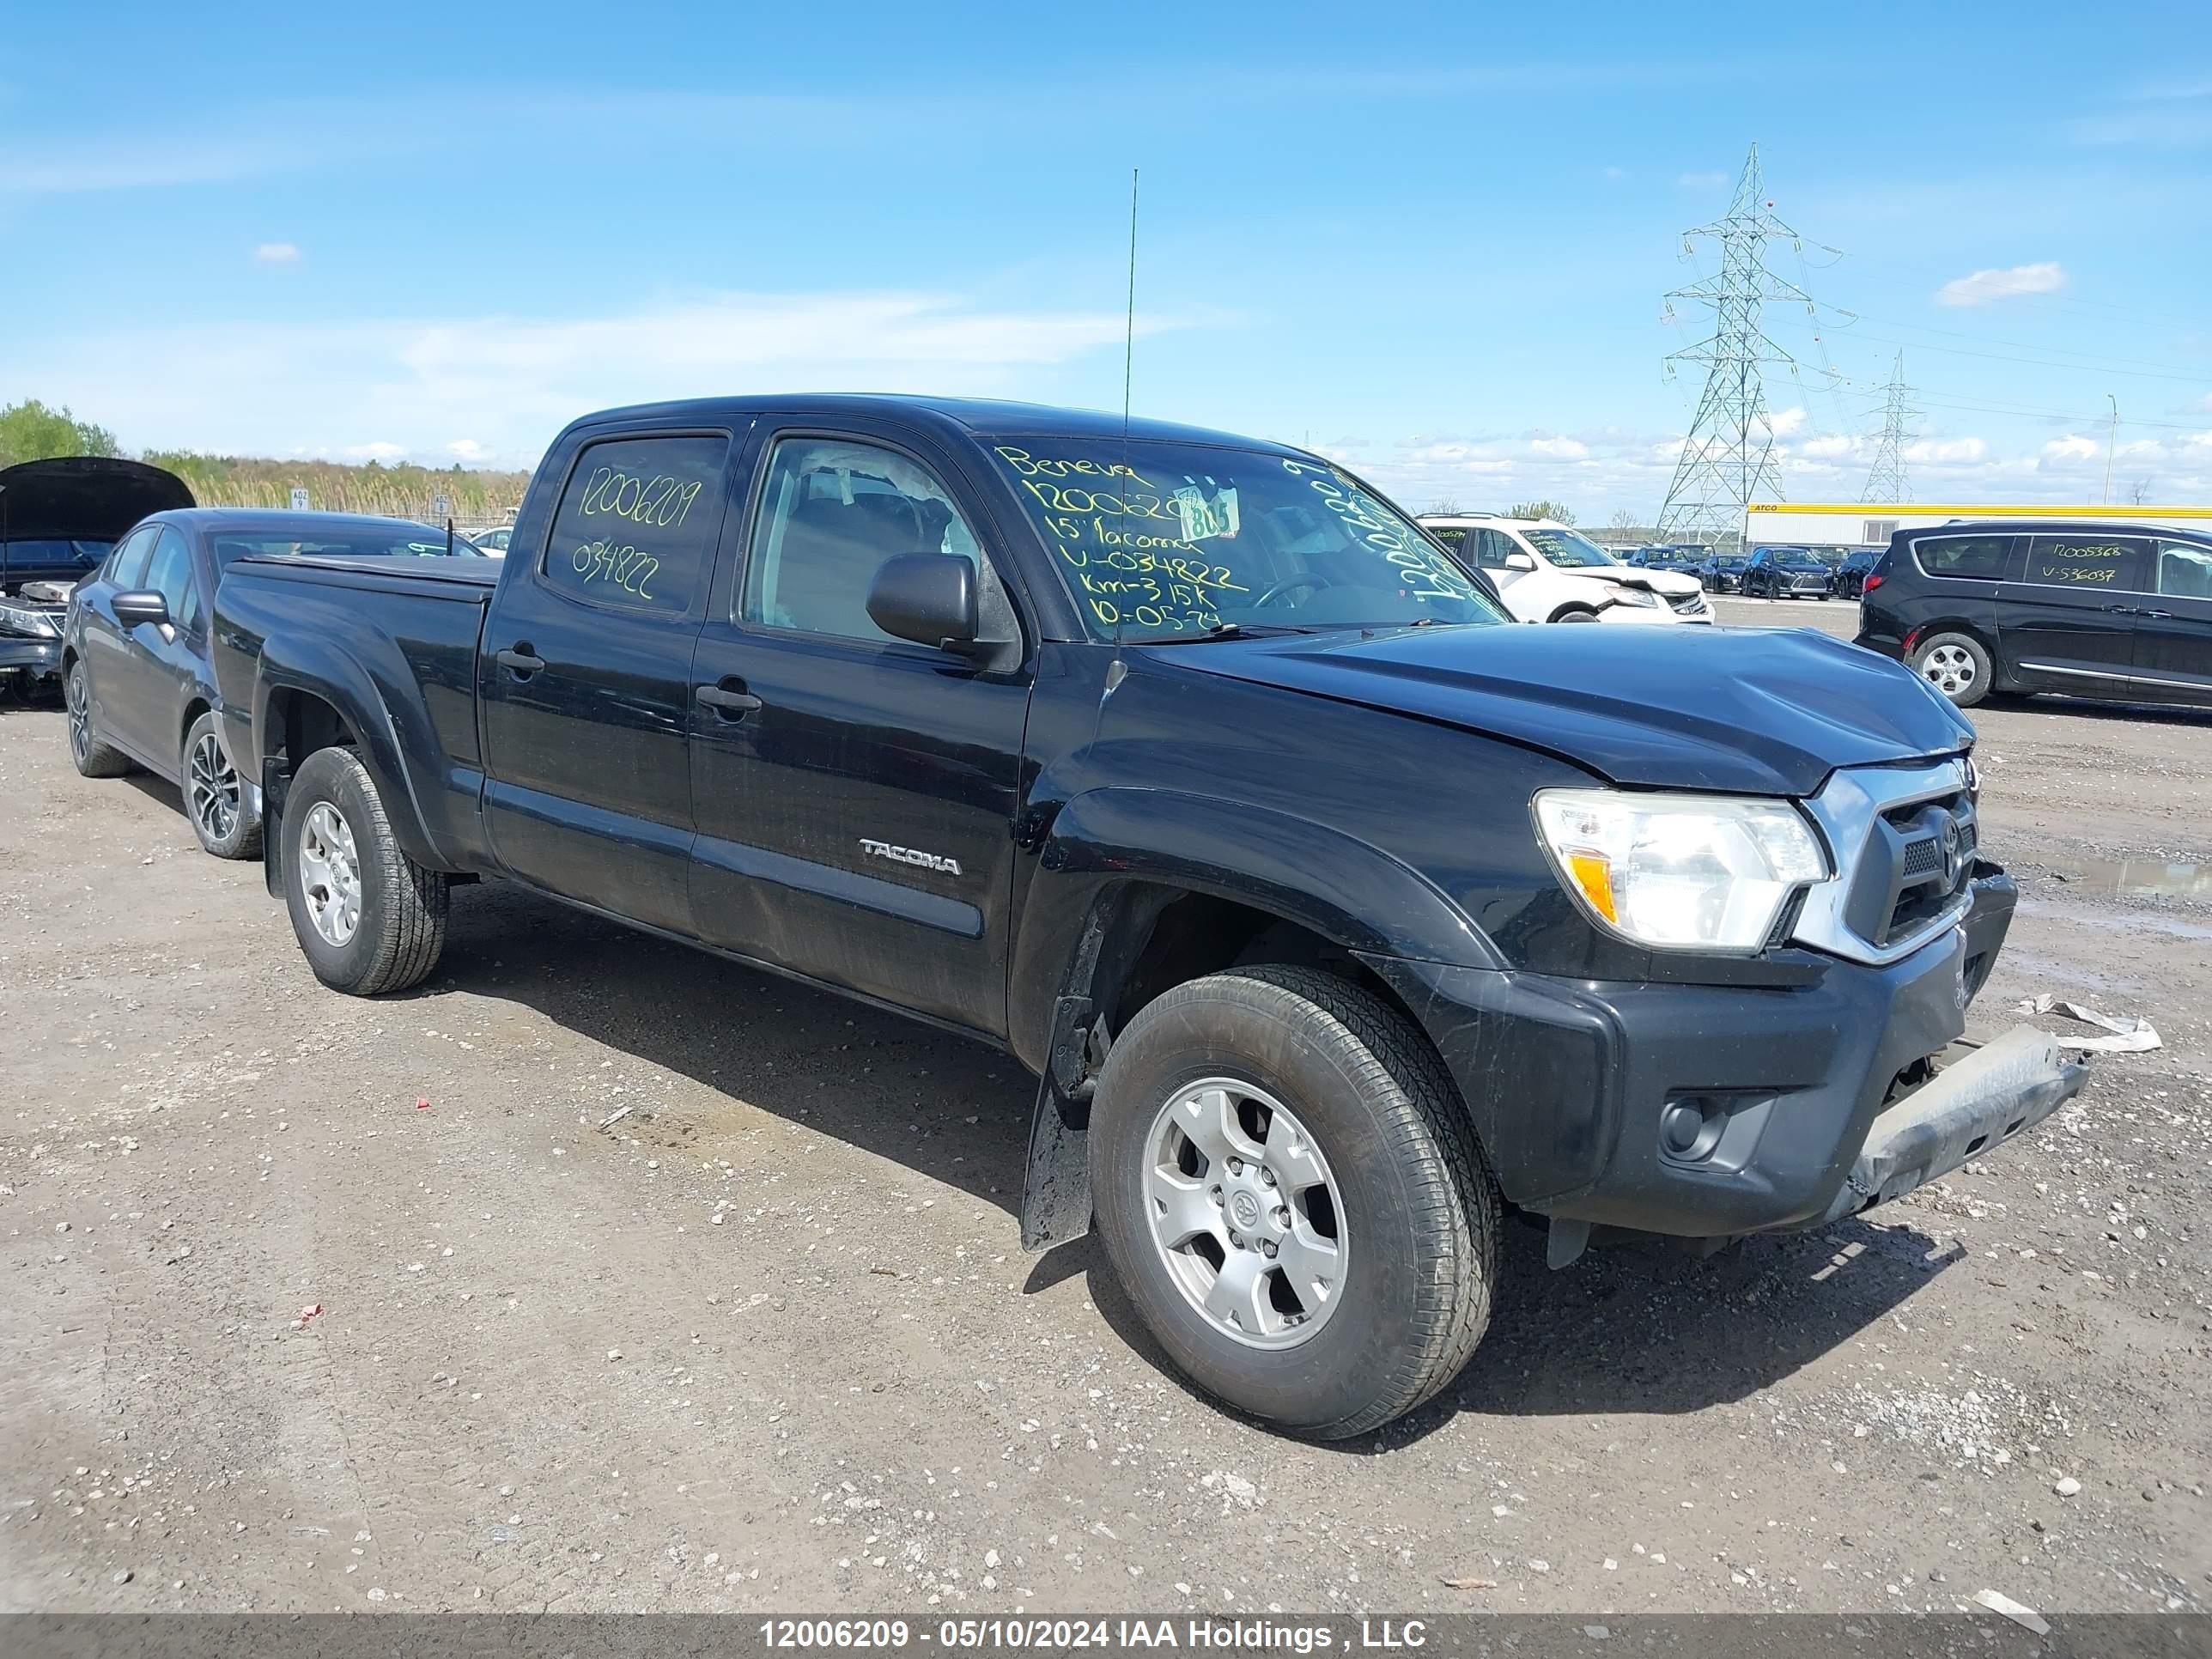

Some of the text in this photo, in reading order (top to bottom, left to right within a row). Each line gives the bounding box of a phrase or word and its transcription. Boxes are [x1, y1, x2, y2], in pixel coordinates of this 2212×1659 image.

[578, 468, 702, 527] 12006209
[1192, 502, 1230, 538] 805
[2054, 544, 2121, 557] 12005368
[573, 541, 659, 599] 034822
[2043, 567, 2115, 582] V-536037
[859, 838, 962, 875] TACOMA
